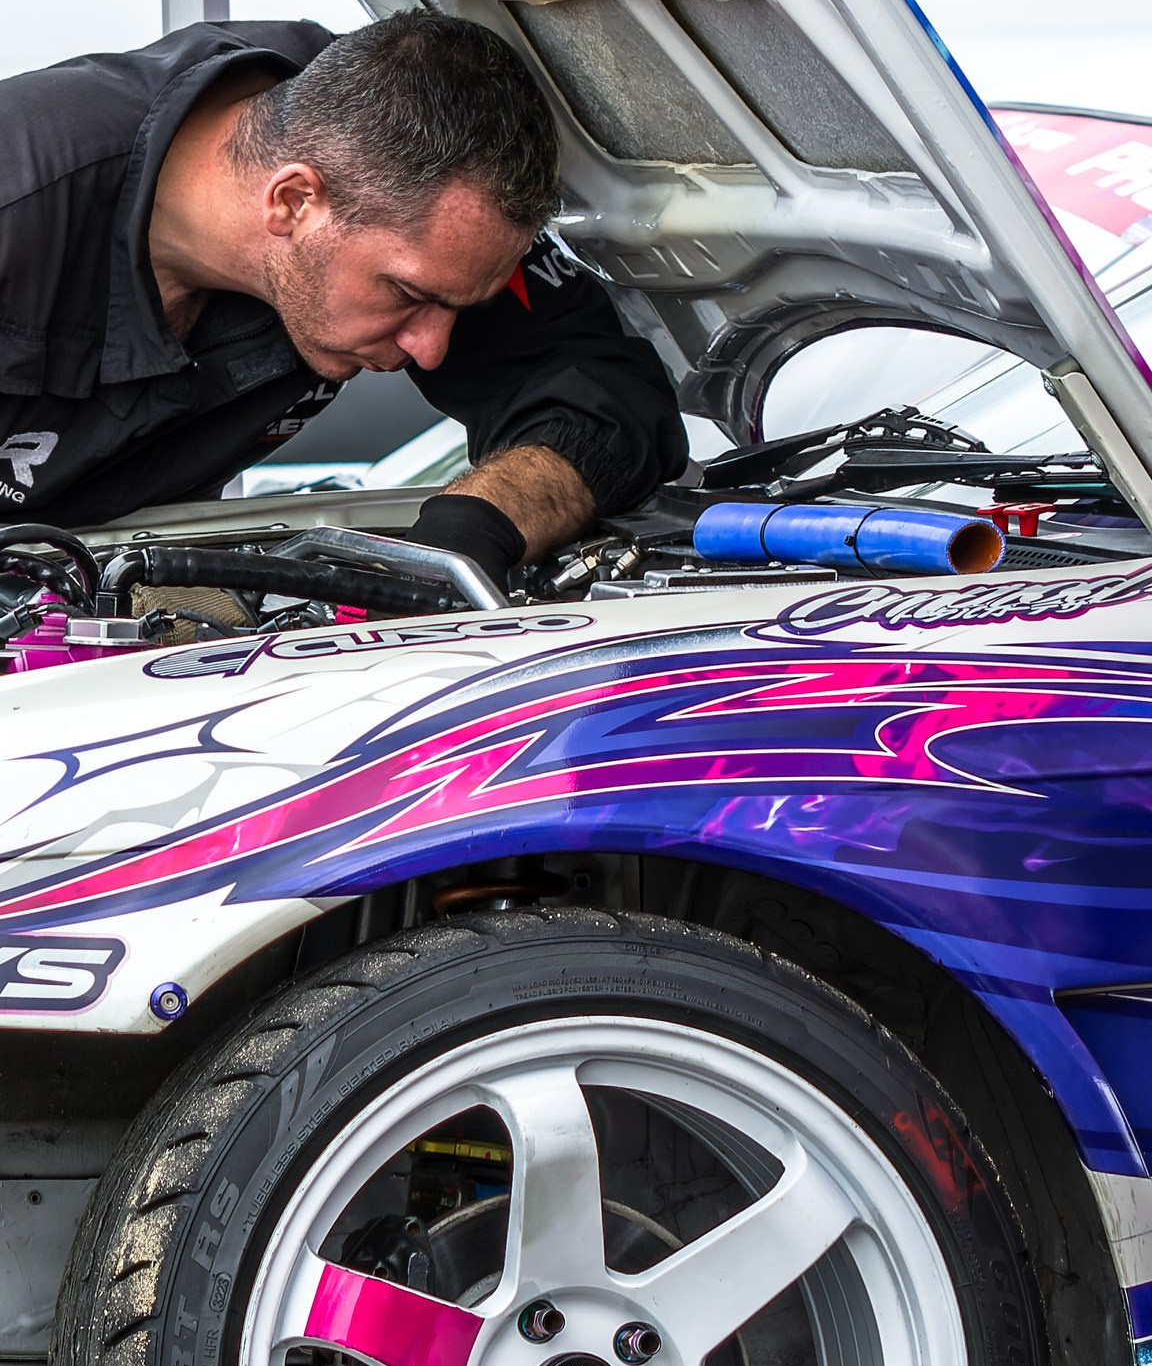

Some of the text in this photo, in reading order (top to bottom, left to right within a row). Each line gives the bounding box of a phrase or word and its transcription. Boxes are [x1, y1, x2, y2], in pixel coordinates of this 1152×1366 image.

[271, 614, 592, 658] CUSCO
[243, 1014, 463, 1226] TUBELESS STEEL BELTED RADIAL
[190, 1176, 242, 1276] RS
